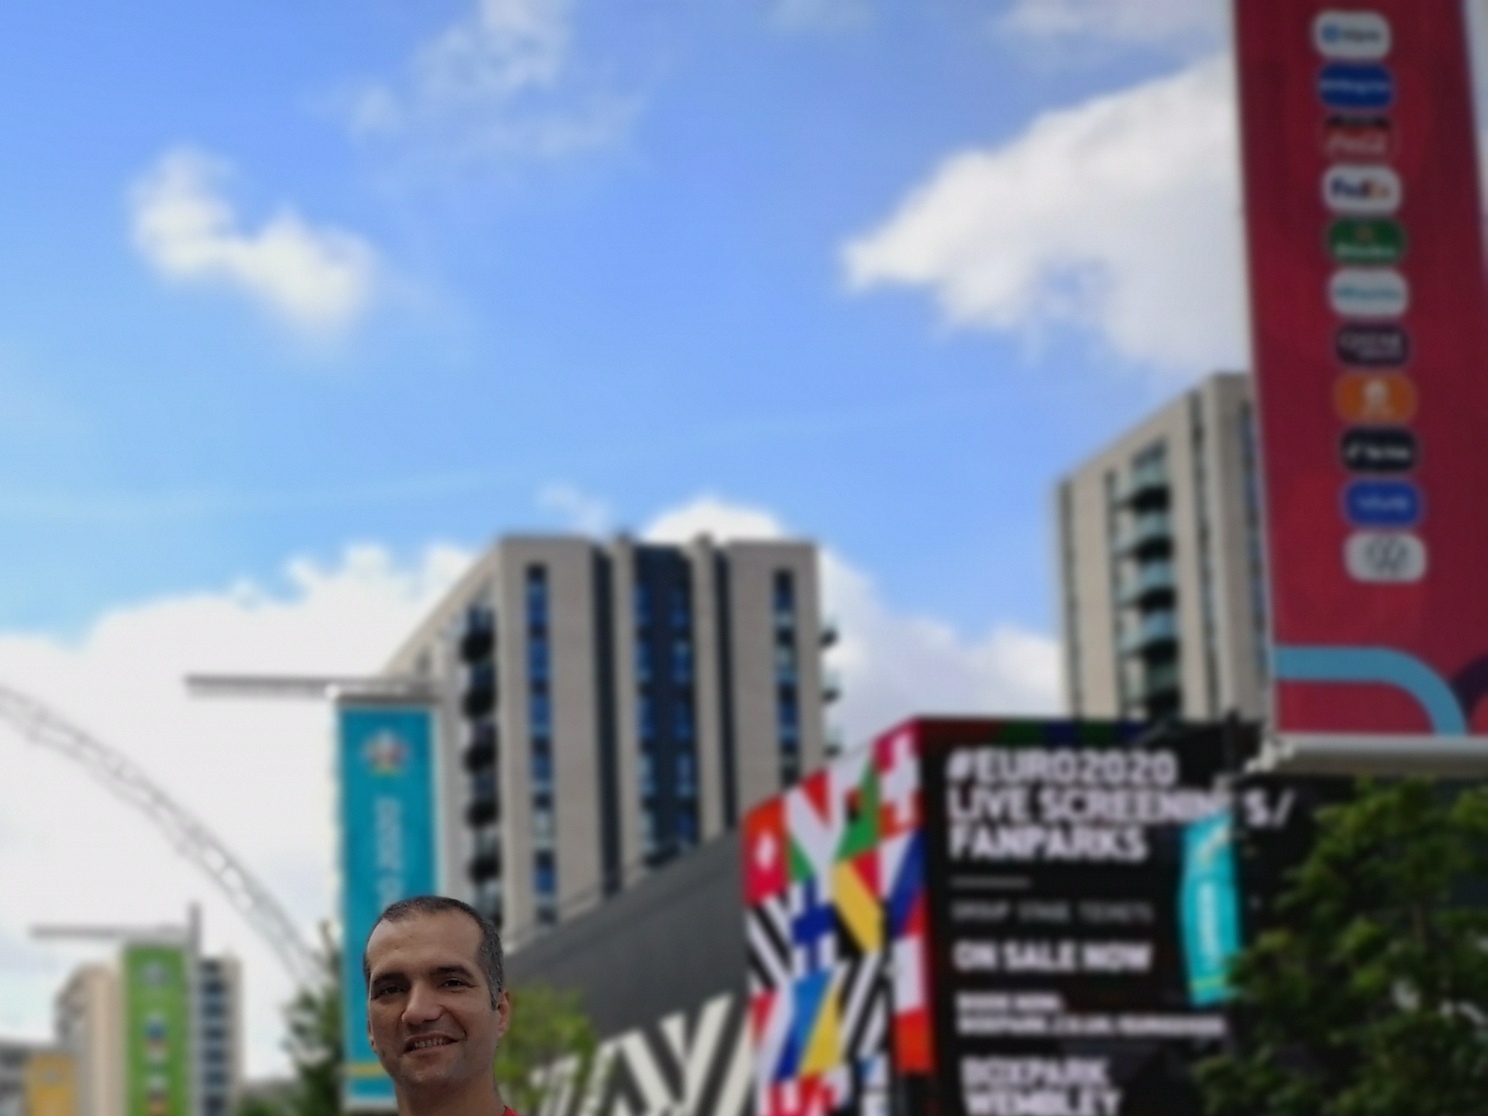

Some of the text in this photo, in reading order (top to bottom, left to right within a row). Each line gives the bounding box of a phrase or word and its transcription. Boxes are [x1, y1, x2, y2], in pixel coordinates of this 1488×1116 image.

[947, 750, 1178, 785] #EURO2020
[948, 786, 1030, 822] LIVE
[951, 826, 1147, 861] FANPARKS
[954, 940, 1152, 971] ON SALE NOW
[961, 1056, 1111, 1088] BOXPARK
